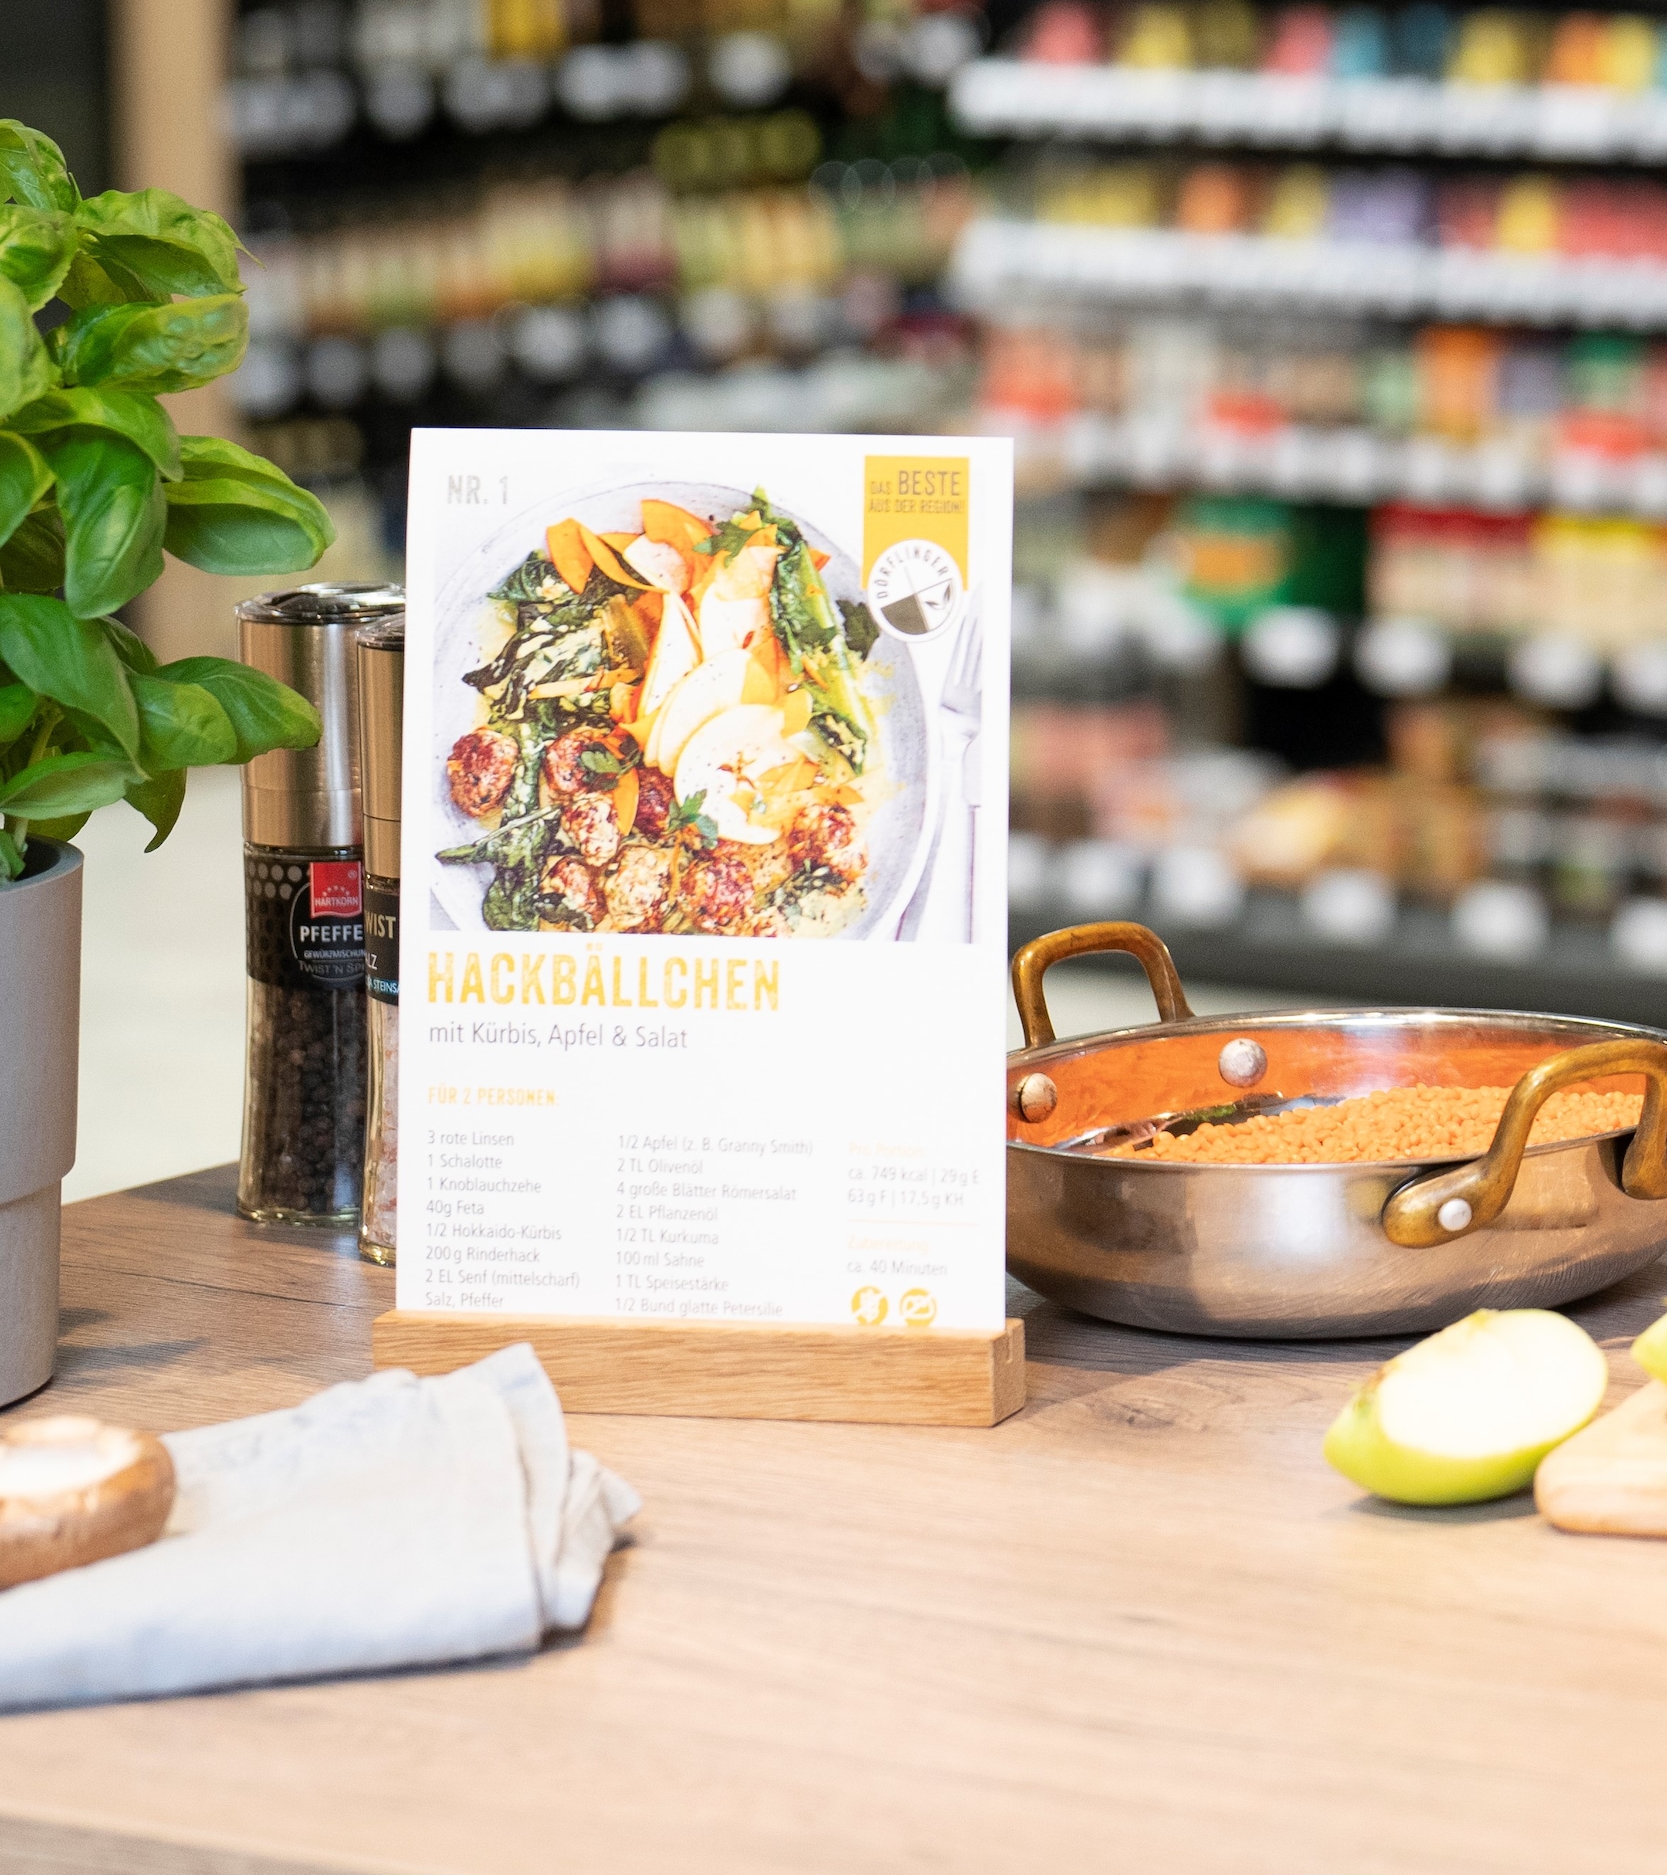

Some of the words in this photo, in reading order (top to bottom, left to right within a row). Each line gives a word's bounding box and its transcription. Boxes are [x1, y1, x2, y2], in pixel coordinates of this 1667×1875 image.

[447, 475, 488, 504] NR.
[499, 476, 508, 504] 1
[870, 481, 892, 495] DAS
[898, 470, 961, 496] BESTE
[868, 499, 890, 513] AUS
[895, 499, 916, 513] DER
[315, 896, 358, 907] HARTKORN
[300, 924, 363, 943] PFEFFE
[365, 910, 396, 940] WIST
[299, 960, 330, 974] TWIST
[427, 943, 781, 1011] HACKBÄLLCHEN
[429, 1021, 464, 1043] mit
[472, 1021, 542, 1048] Kürbis,
[547, 1023, 603, 1051] Apfel
[612, 1025, 627, 1047] &
[635, 1025, 688, 1049] Salat
[428, 1082, 457, 1105] FÜR
[463, 1087, 472, 1105] 2
[477, 1087, 560, 1107] PERSONEN:
[427, 1130, 435, 1144] 3
[440, 1133, 467, 1145] rote
[472, 1131, 515, 1146] Linsen
[618, 1135, 638, 1149] 1/2
[642, 1135, 677, 1152] Apfel
[718, 1138, 766, 1157] Granny
[428, 1154, 433, 1167] 1
[440, 1154, 502, 1169] Schalotte
[617, 1158, 624, 1172] 2
[630, 1159, 644, 1173] TL
[648, 1158, 704, 1174] Olivenöl
[872, 1166, 897, 1181] 749
[901, 1167, 927, 1182] kcal
[972, 1169, 981, 1184] E
[428, 1177, 433, 1190] 1
[440, 1177, 542, 1193] Knoblauchzehe
[616, 1181, 625, 1195] 4
[629, 1181, 667, 1199] große
[673, 1183, 717, 1198] Blätter
[722, 1184, 797, 1201] Römersalat
[457, 1200, 484, 1215] Feta
[945, 1192, 964, 1206] KH
[616, 1205, 624, 1218] 2
[630, 1205, 644, 1219] EL
[649, 1205, 719, 1221] Pflanzenöl
[427, 1223, 447, 1237] 1/2
[452, 1223, 562, 1240] Hokkaido-Kürbis
[616, 1228, 636, 1243] 1/2
[642, 1228, 656, 1243] TL
[660, 1229, 719, 1245] Kurkuma
[467, 1247, 540, 1263] Rinderhack
[664, 1252, 705, 1268] Sahne
[870, 1260, 887, 1273] 40
[892, 1260, 948, 1276] Minuten
[426, 1269, 433, 1283] 2
[439, 1270, 453, 1284] EL
[458, 1269, 488, 1284] Senf
[492, 1270, 580, 1289] (mittelscharf)
[616, 1275, 622, 1289] 1
[627, 1275, 641, 1289] TL
[646, 1275, 729, 1292] Speisestärke
[426, 1292, 456, 1308] Salz,
[461, 1293, 504, 1308] Pfeffer
[616, 1298, 636, 1312] 1/2
[641, 1298, 675, 1313] Bund
[679, 1300, 718, 1317] glatte
[723, 1301, 783, 1316] Petersilie
